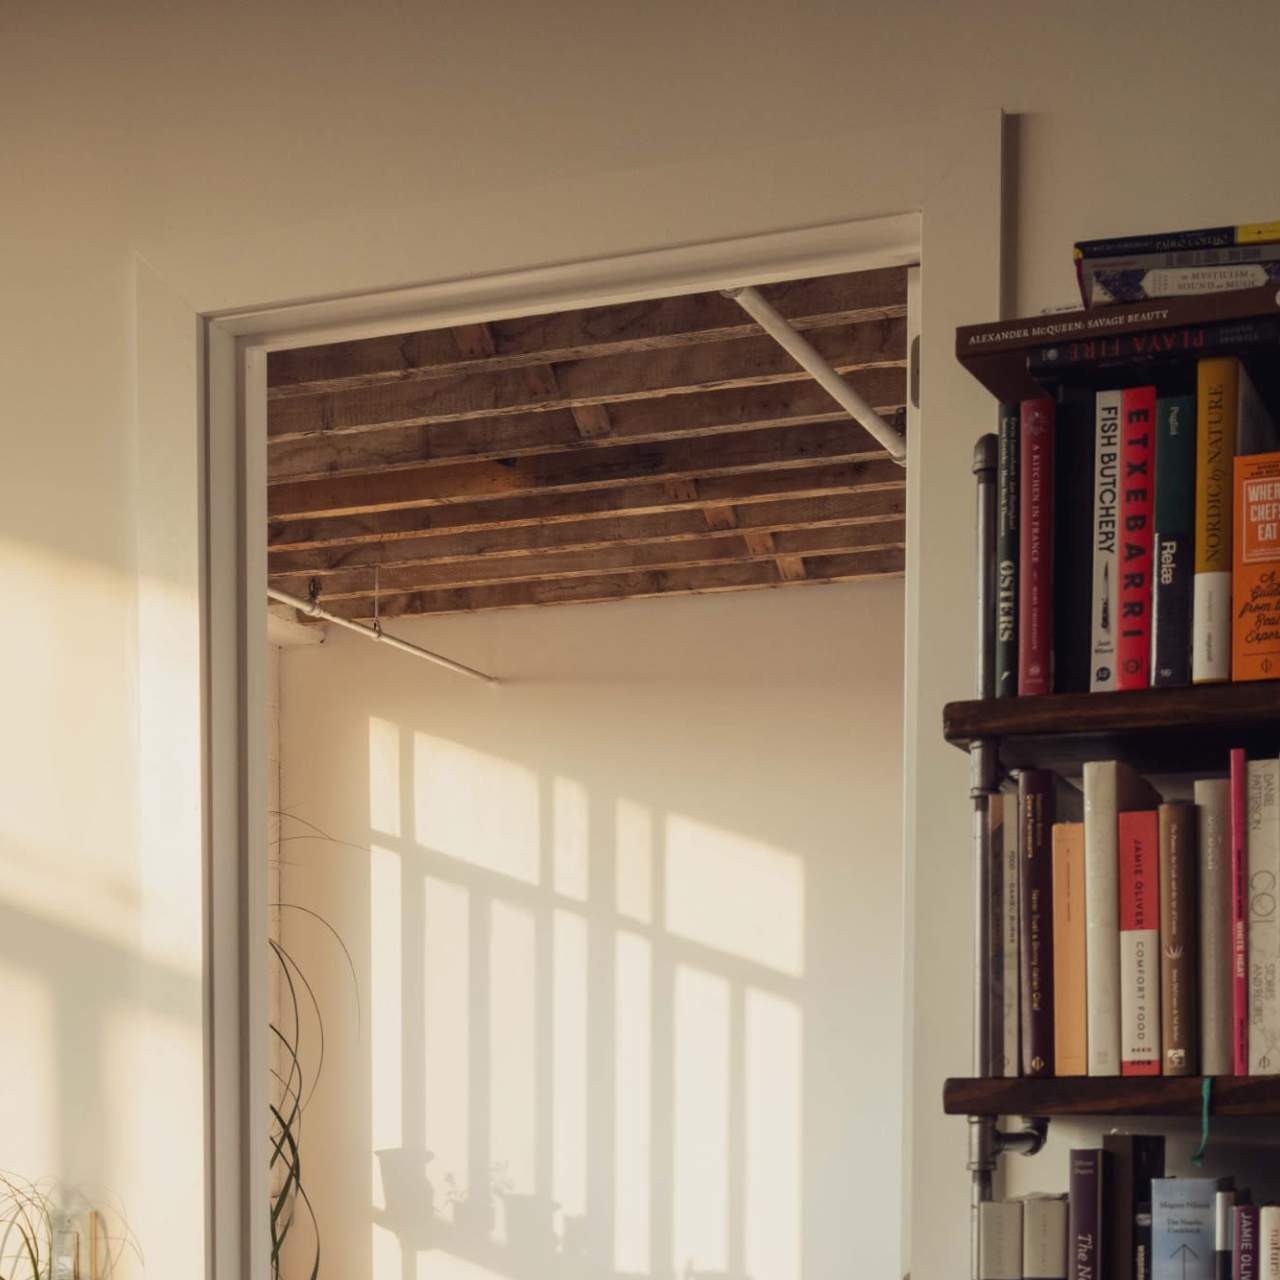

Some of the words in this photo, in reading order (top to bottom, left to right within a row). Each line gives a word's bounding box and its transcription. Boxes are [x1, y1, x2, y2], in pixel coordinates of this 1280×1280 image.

[1101, 405, 1119, 448] FISH
[1098, 452, 1118, 554] BUTCHERY
[1123, 407, 1150, 638] ETXEBARRI
[1257, 523, 1278, 541] EAT
[998, 560, 1015, 643] ØSTERS
[1250, 774, 1262, 831] PATTERSON
[1263, 773, 1274, 806] DANIEL
[1133, 839, 1145, 877] JAMIE
[1134, 881, 1145, 927] OLIVER
[1135, 942, 1146, 1001] COMFORT
[1135, 1006, 1146, 1040] FOOD
[1077, 1233, 1093, 1260] The
[1240, 1211, 1252, 1250] JAMIE
